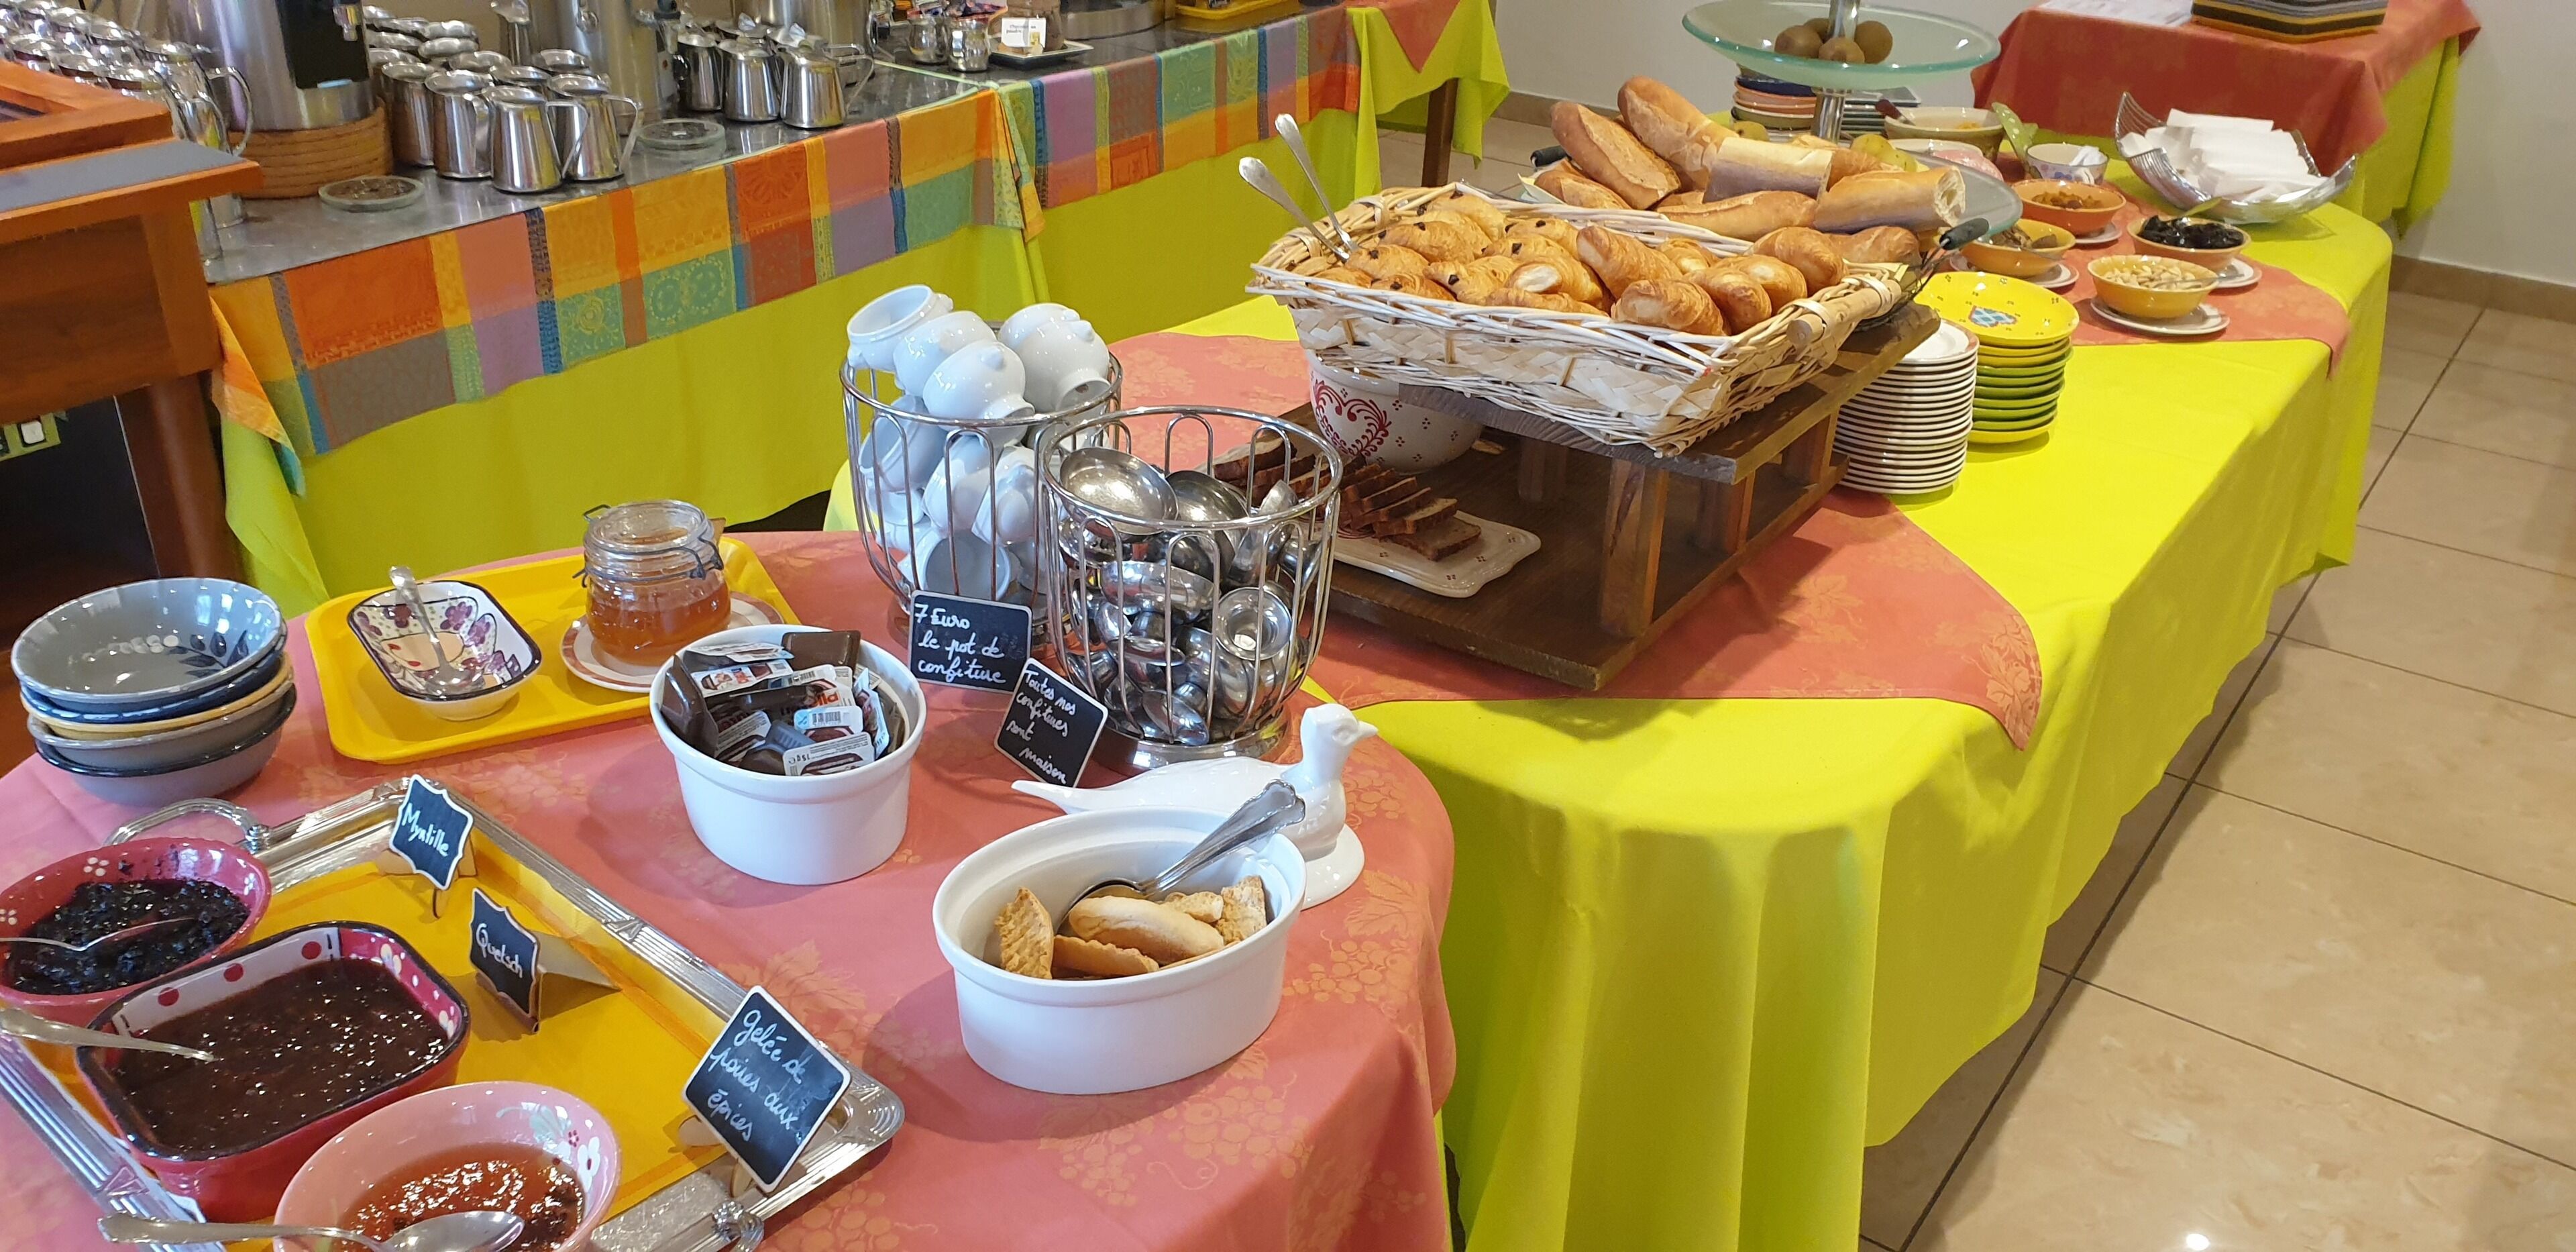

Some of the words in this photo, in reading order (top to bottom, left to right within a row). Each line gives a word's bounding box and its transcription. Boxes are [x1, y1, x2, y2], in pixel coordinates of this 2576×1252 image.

[914, 603, 928, 623] 7
[930, 608, 970, 629] Euro
[918, 631, 940, 649] le
[945, 633, 977, 660] pot
[981, 637, 1005, 658] de
[918, 659, 1006, 682] confiture
[1023, 670, 1055, 700] Toutes
[1055, 696, 1076, 715] nos
[1006, 721, 1035, 741] sont
[1016, 692, 1069, 737] confitures
[1018, 747, 1067, 784] maison
[476, 923, 523, 979] Quetsch
[708, 1047, 762, 1093] poires
[763, 1092, 798, 1130] aux
[707, 1088, 753, 1141] épices
